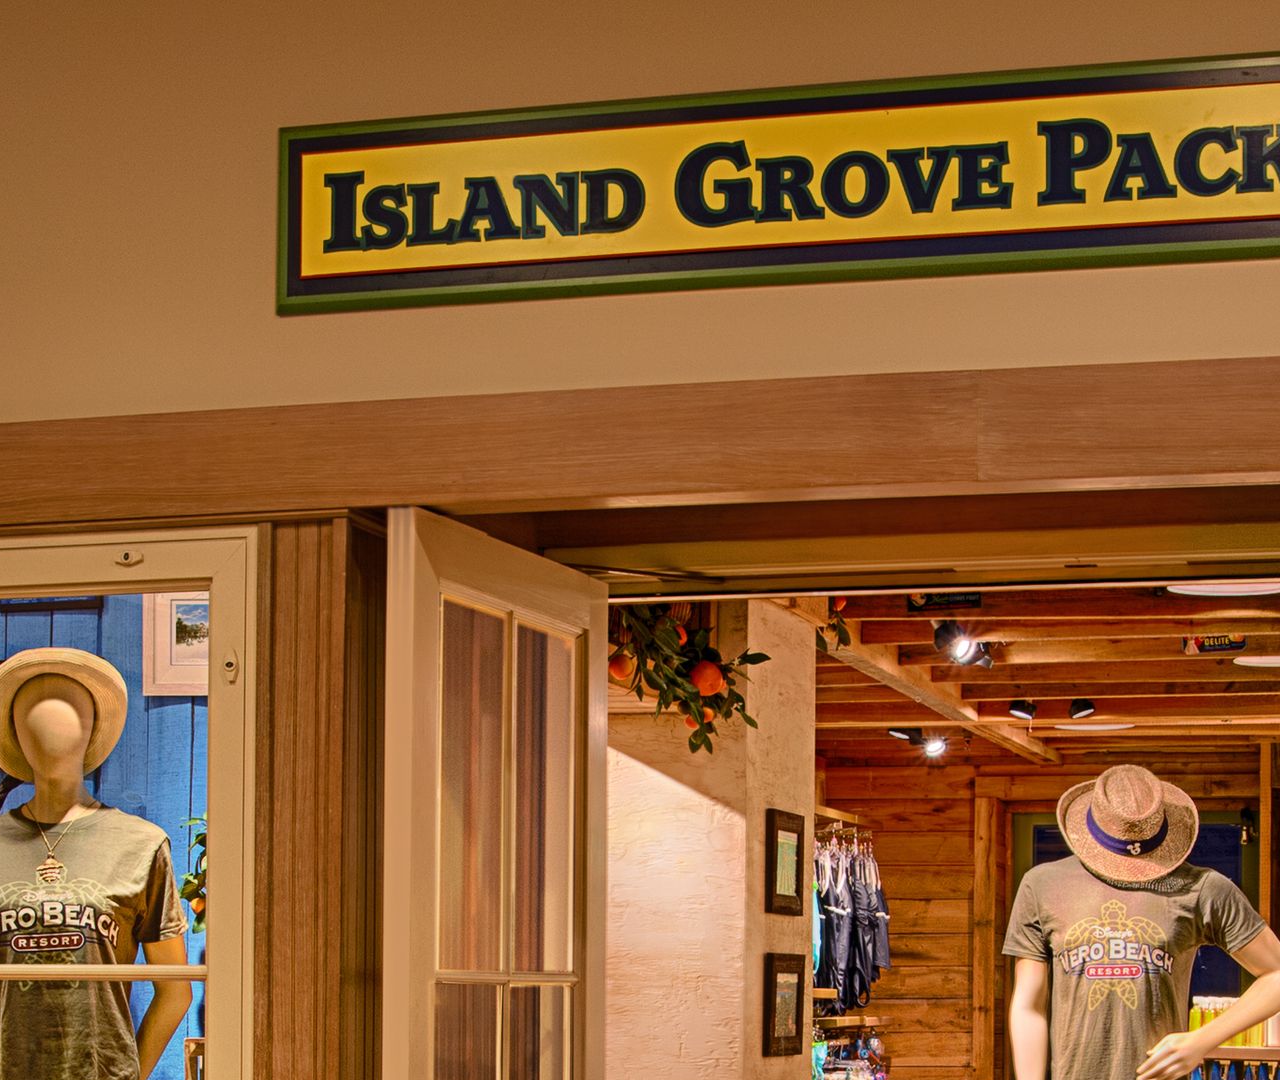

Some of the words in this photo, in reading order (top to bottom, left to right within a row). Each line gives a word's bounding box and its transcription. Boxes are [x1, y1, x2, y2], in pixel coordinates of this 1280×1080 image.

[321, 167, 647, 255] ISLAND
[674, 139, 1014, 228] GROVE
[18, 936, 80, 948] RESORT
[42, 901, 120, 948] BEACH
[1060, 942, 1105, 973] VERO
[1108, 938, 1174, 974] BEACH
[1088, 967, 1138, 976] RESORT
